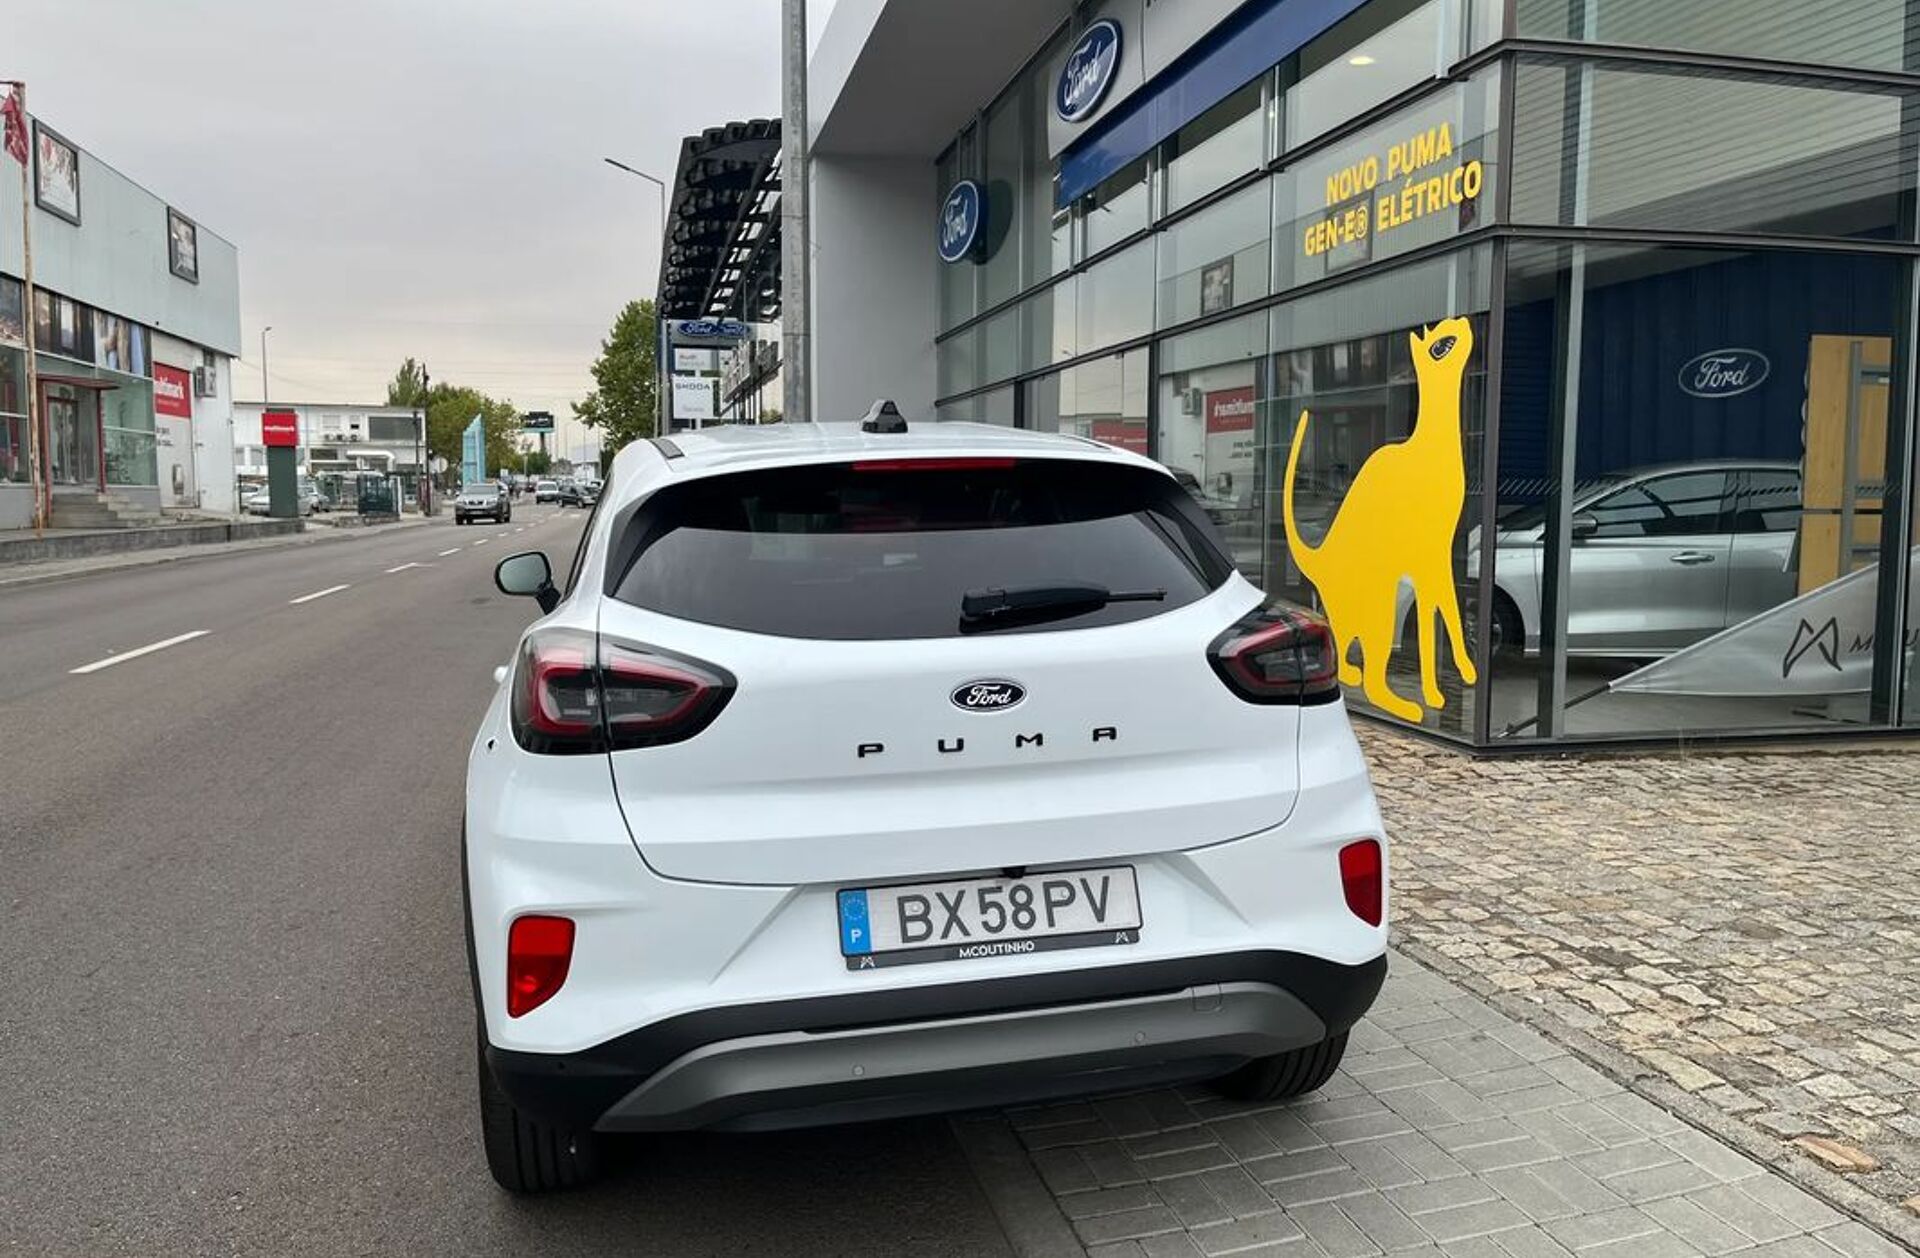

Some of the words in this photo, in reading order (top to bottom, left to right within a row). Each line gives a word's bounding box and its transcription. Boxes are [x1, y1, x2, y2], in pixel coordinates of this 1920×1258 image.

[1326, 155, 1378, 207] NOVO
[1387, 122, 1452, 181] PUMA
[1377, 160, 1482, 232] ELÉTRICO
[1694, 356, 1750, 389] Ford
[965, 684, 1012, 707] Ford
[857, 725, 1117, 759] PUMA
[850, 928, 862, 944] P
[959, 940, 1035, 959] MCOUTINHO
